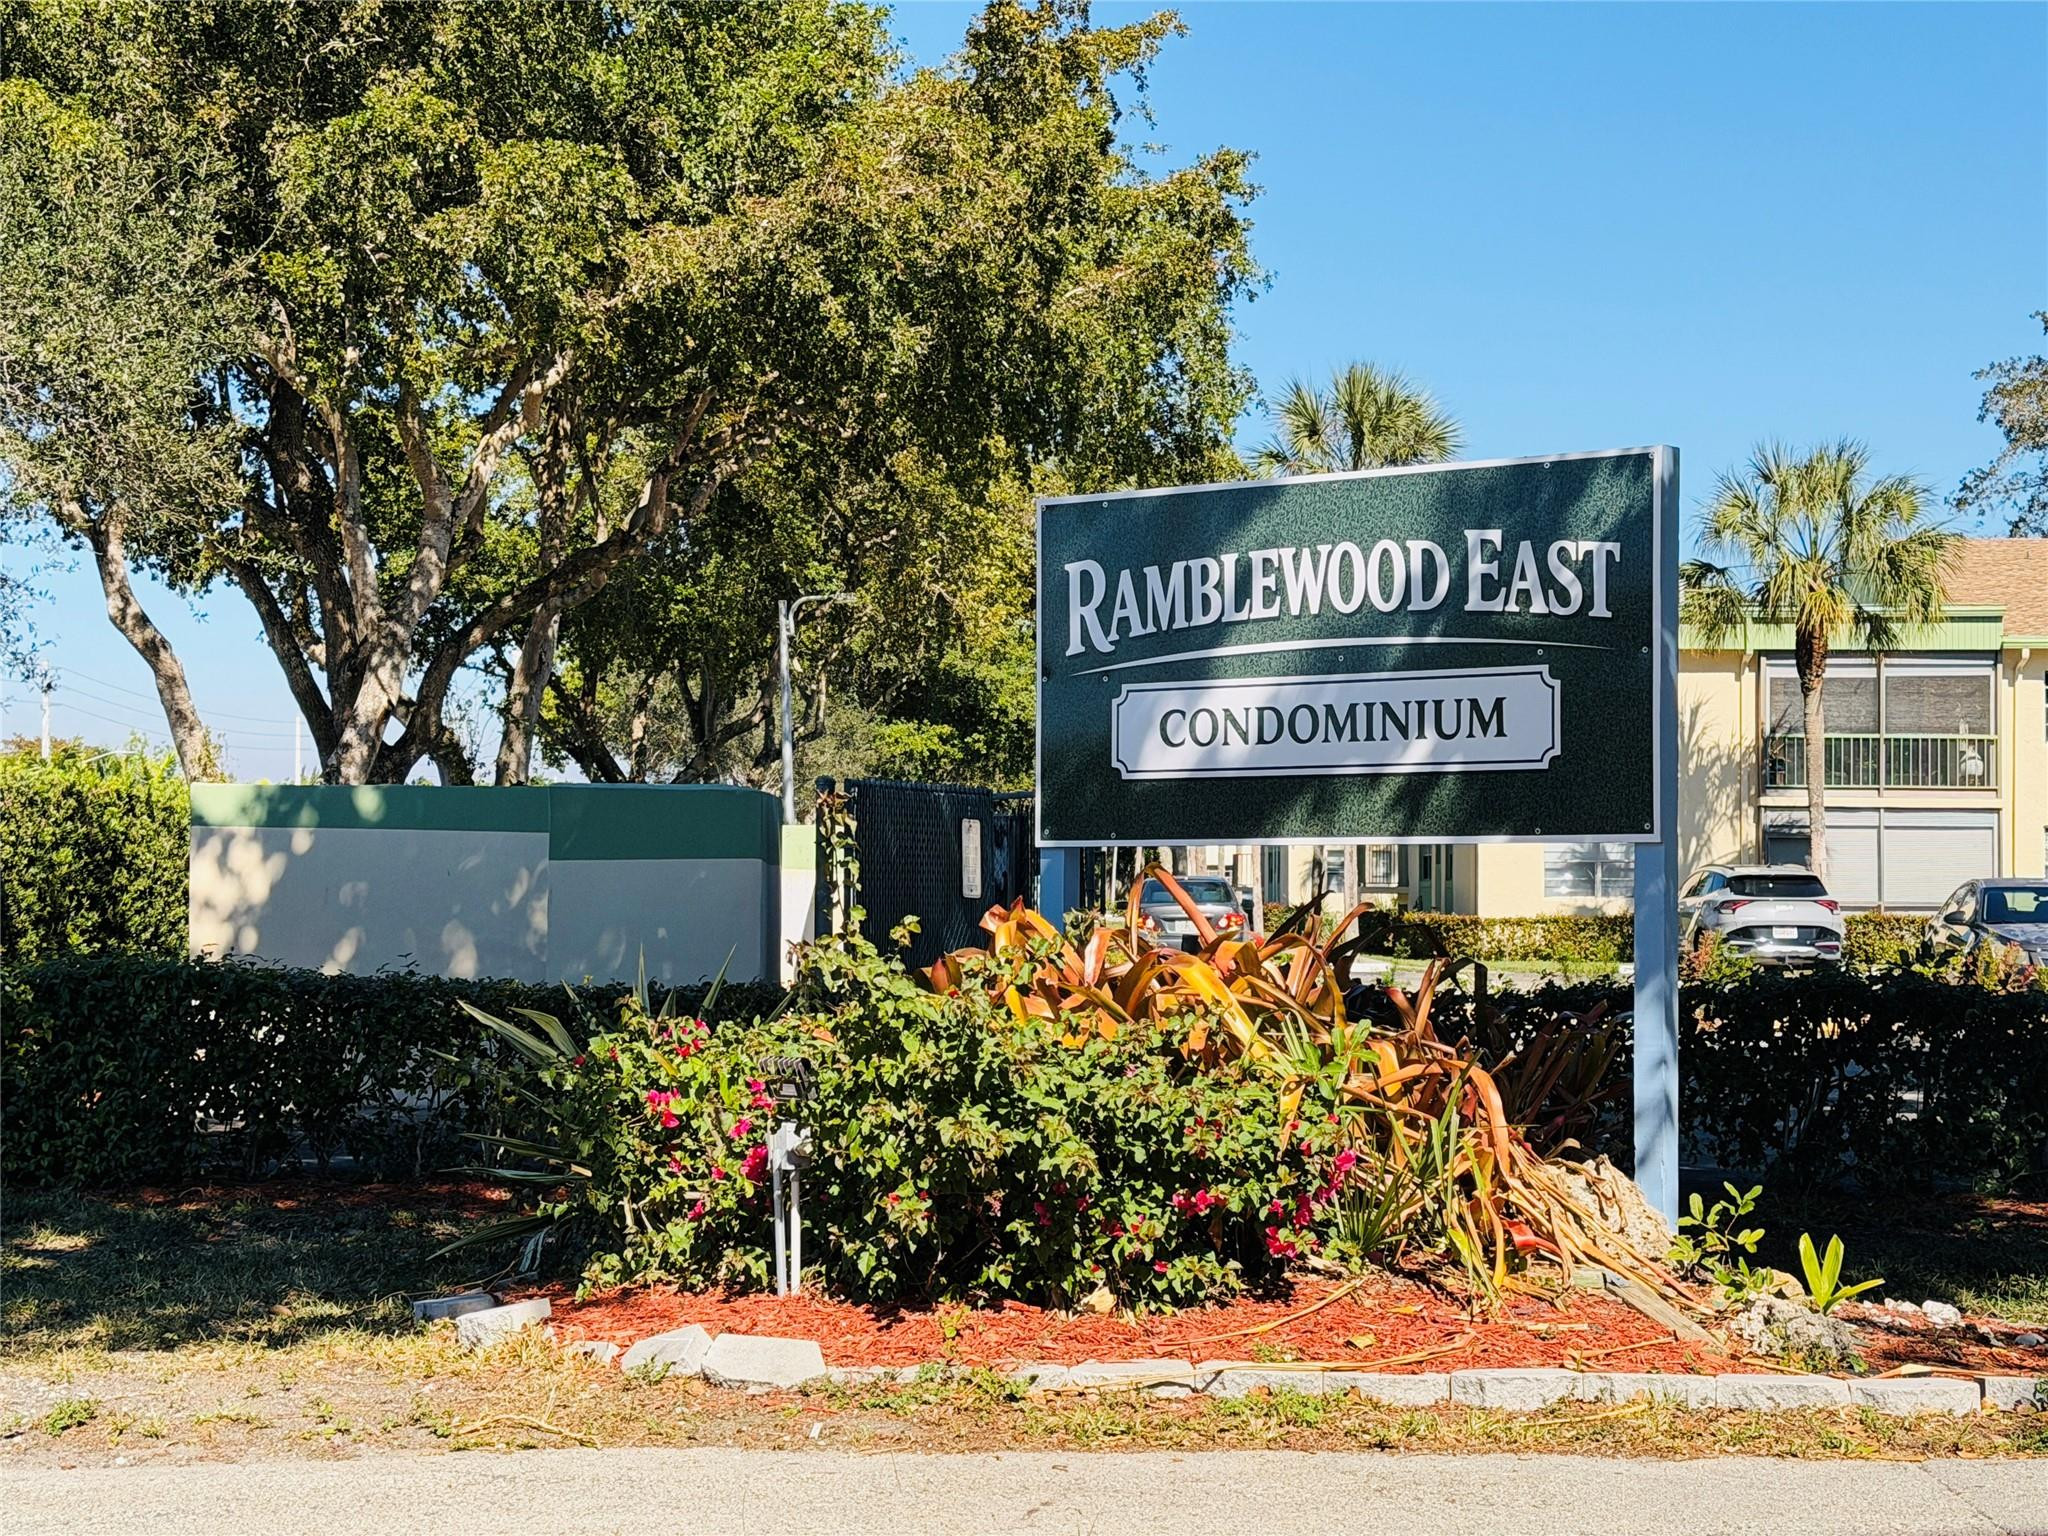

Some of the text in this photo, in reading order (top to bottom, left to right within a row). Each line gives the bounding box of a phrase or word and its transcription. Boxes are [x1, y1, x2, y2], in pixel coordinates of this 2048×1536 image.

[1064, 528, 1621, 657] RAMBLEWOOD EAST
[1159, 696, 1508, 748] CONDOMINIUM
